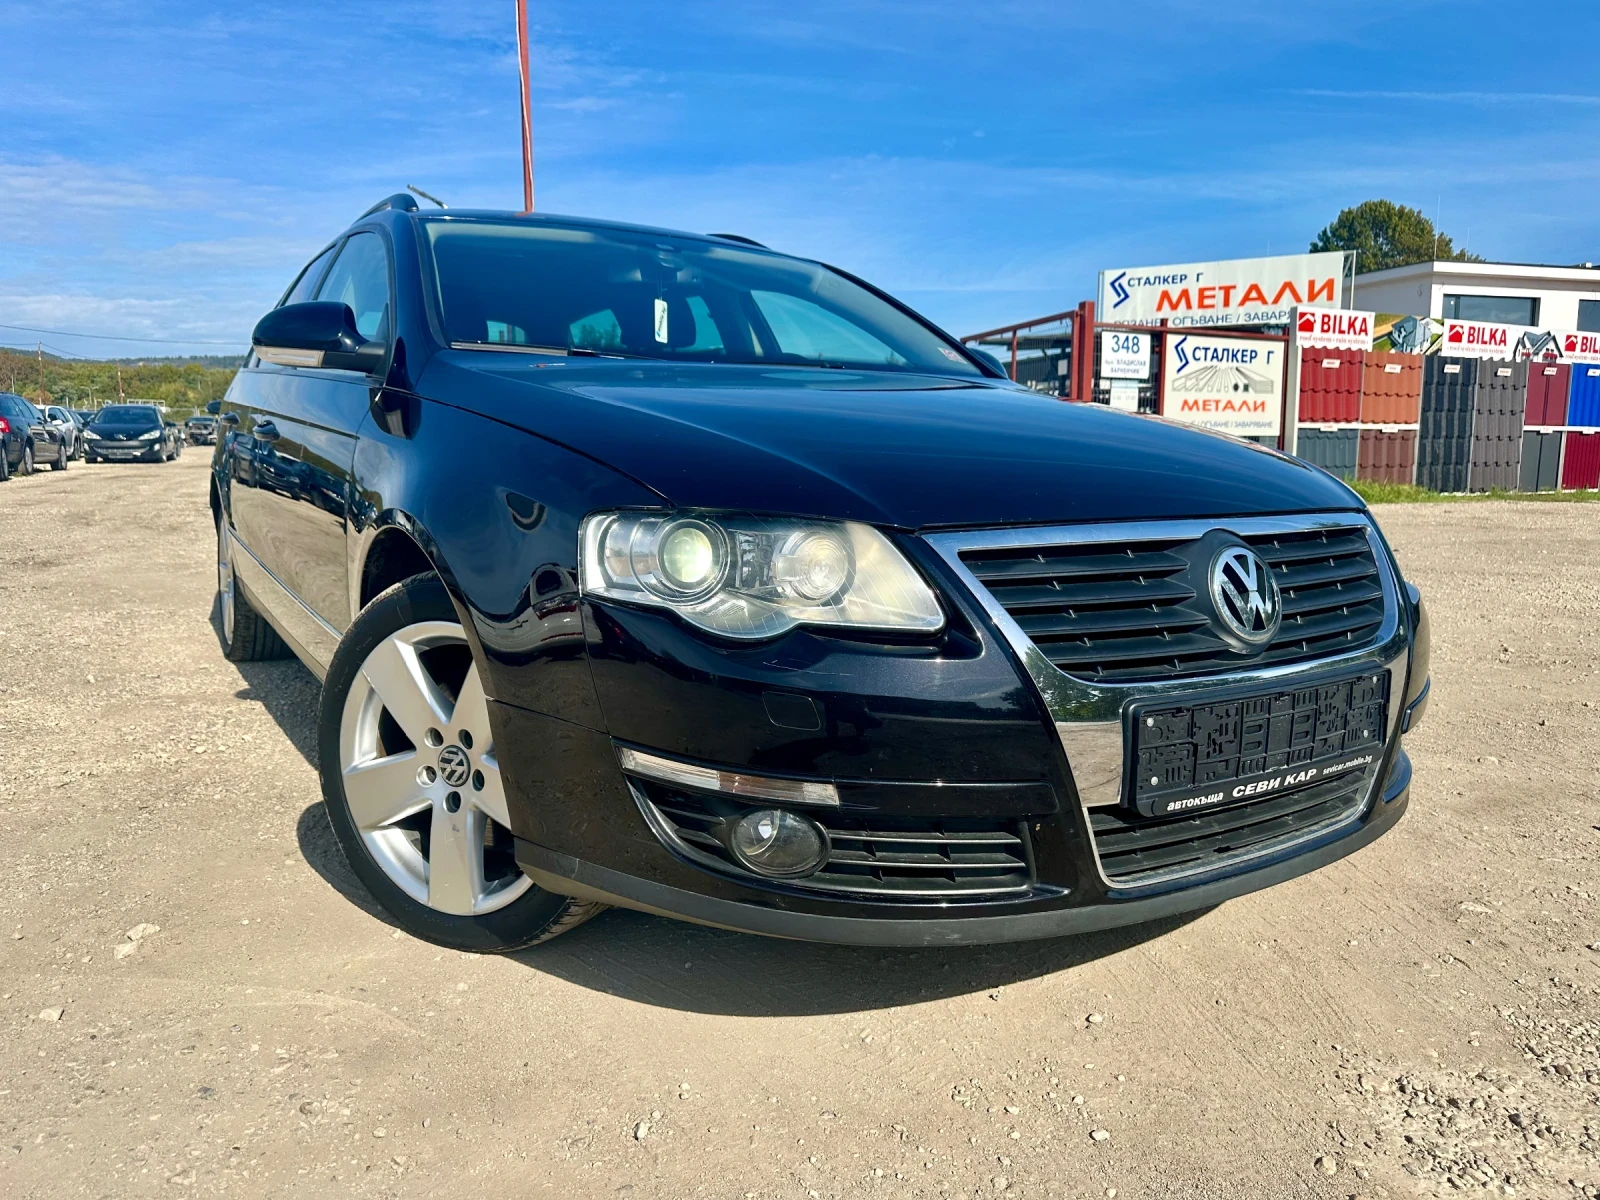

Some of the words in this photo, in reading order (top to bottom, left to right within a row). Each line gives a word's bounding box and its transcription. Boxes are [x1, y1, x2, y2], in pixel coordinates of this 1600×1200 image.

[1127, 274, 1188, 288] СТАЛКЕР
[1196, 272, 1204, 283] Г
[1155, 277, 1335, 312] МЕТАЛИ
[1172, 314, 1233, 327] ОГЪВАНЕ
[1321, 313, 1368, 336] BILKA
[1111, 334, 1140, 354] 348
[1467, 326, 1507, 346] BILKA
[1580, 336, 1600, 354] BIL
[1192, 346, 1258, 364] СТАЛКЕР
[1266, 350, 1275, 365] Г
[1181, 399, 1266, 413] МЕТАЛИ
[1166, 792, 1224, 811] автокъща
[1232, 777, 1281, 797] СЕВИ
[1284, 768, 1317, 786] КАР
